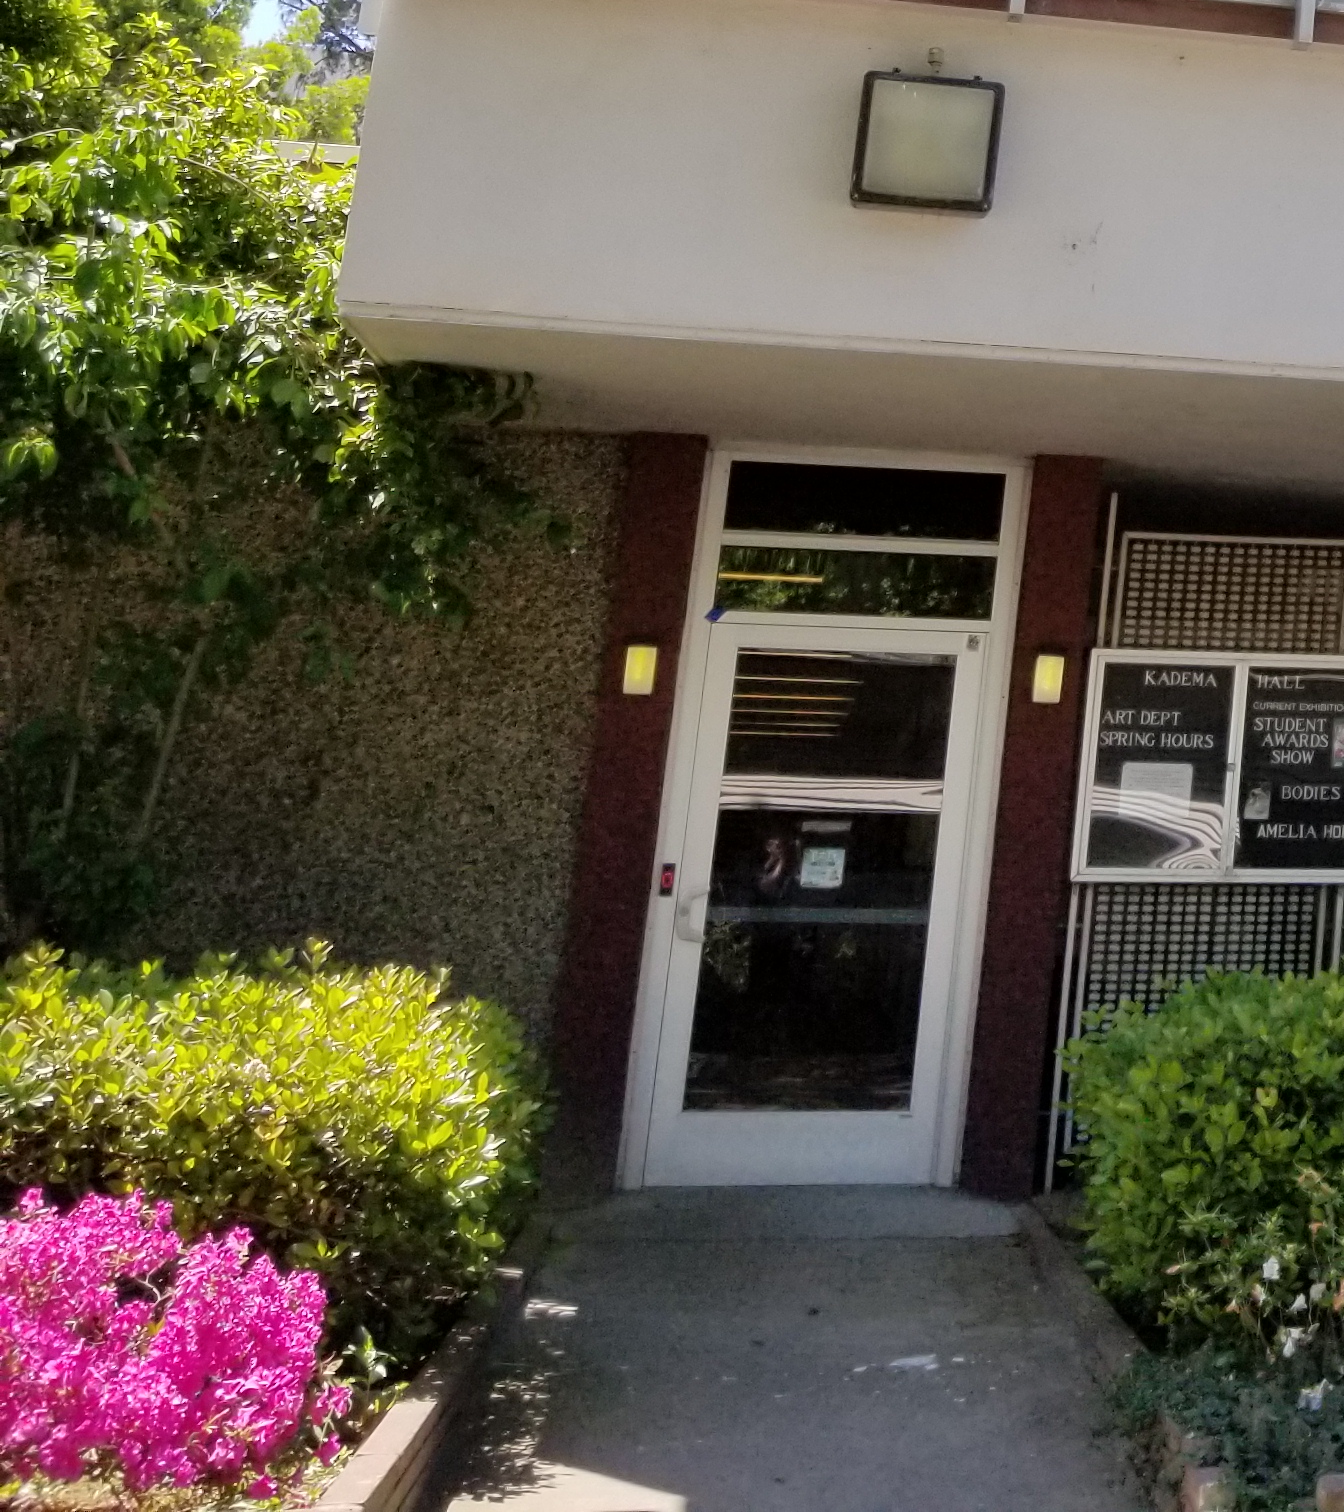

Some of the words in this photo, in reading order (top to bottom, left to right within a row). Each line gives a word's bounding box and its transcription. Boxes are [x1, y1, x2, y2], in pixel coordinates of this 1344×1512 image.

[1144, 669, 1217, 687] KADEMA
[1257, 675, 1305, 689] HALL
[1253, 701, 1296, 710] CURRENT
[1102, 710, 1136, 725] ART
[1140, 710, 1181, 726] DEPT
[1254, 717, 1327, 732] STUDENT
[1100, 731, 1156, 747] SPRING
[1161, 733, 1214, 748] HOURS
[1262, 733, 1329, 747] AWARDS
[1270, 750, 1315, 764] SHOW
[1282, 786, 1341, 800] BODIES
[1257, 824, 1317, 839] AMELIA
